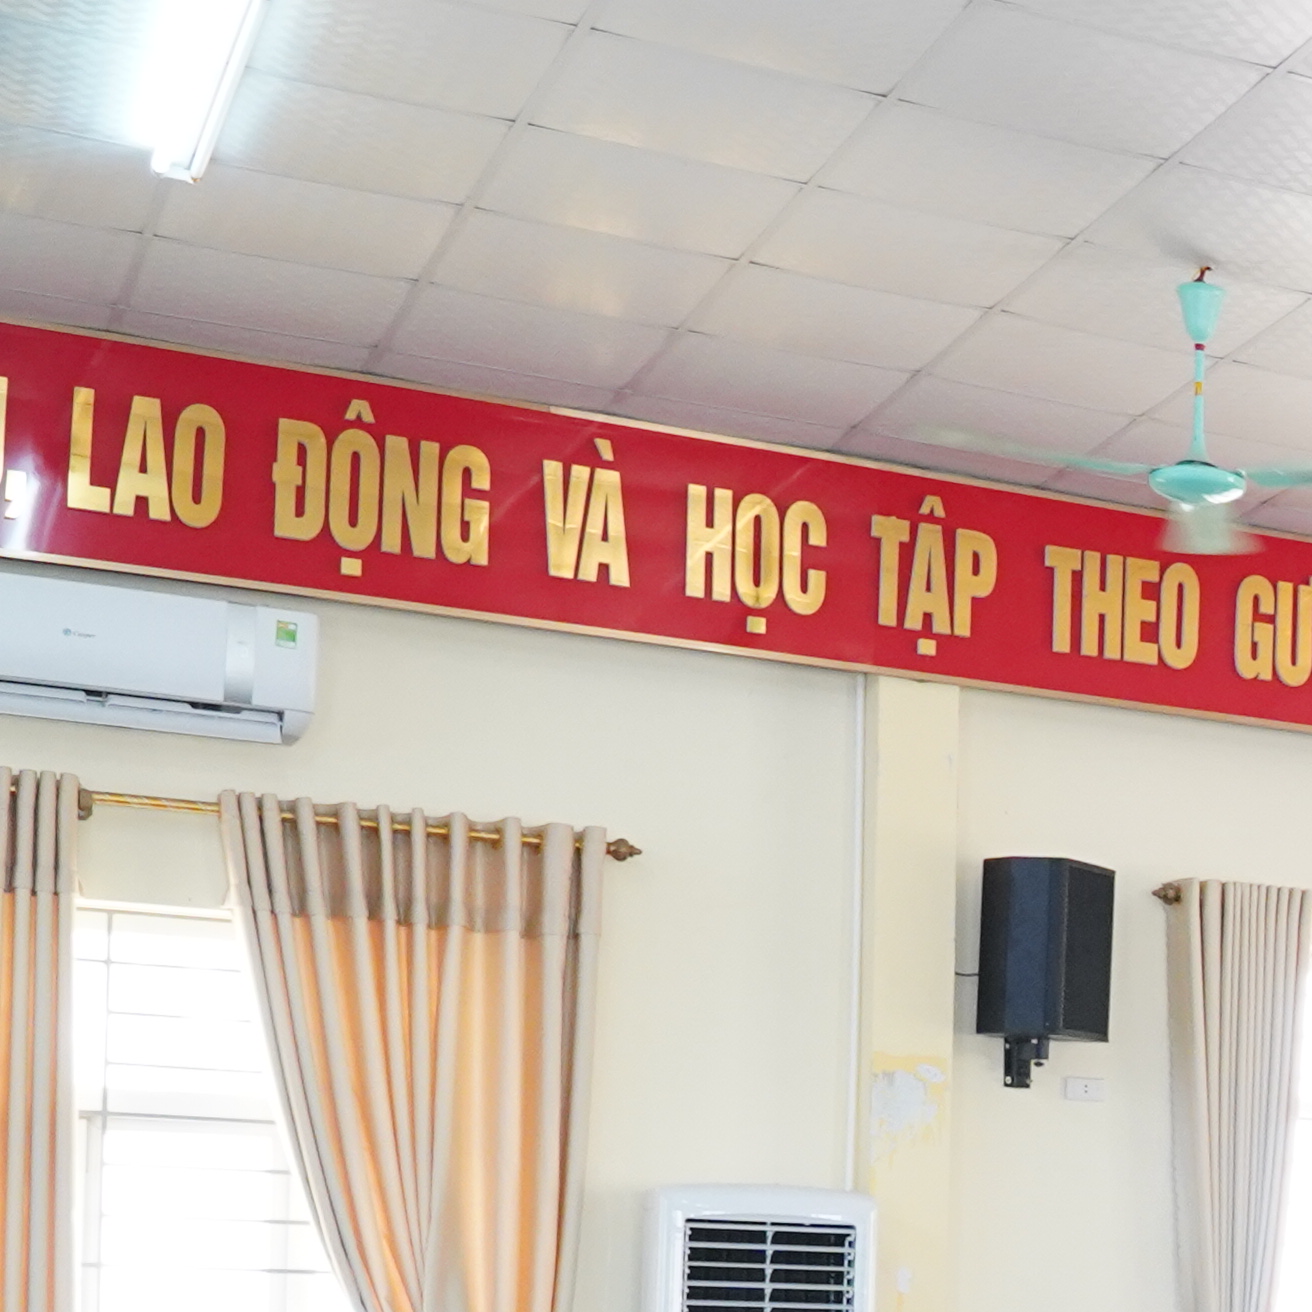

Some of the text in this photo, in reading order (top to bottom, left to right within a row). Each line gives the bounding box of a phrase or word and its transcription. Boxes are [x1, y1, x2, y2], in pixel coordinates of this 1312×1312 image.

[66, 386, 226, 529] LAO
[272, 399, 491, 577] ĐỘNG
[542, 437, 631, 588] VÀ
[685, 482, 828, 635] HỌC
[871, 495, 998, 657] TẬP
[1044, 544, 1201, 671] THEO
